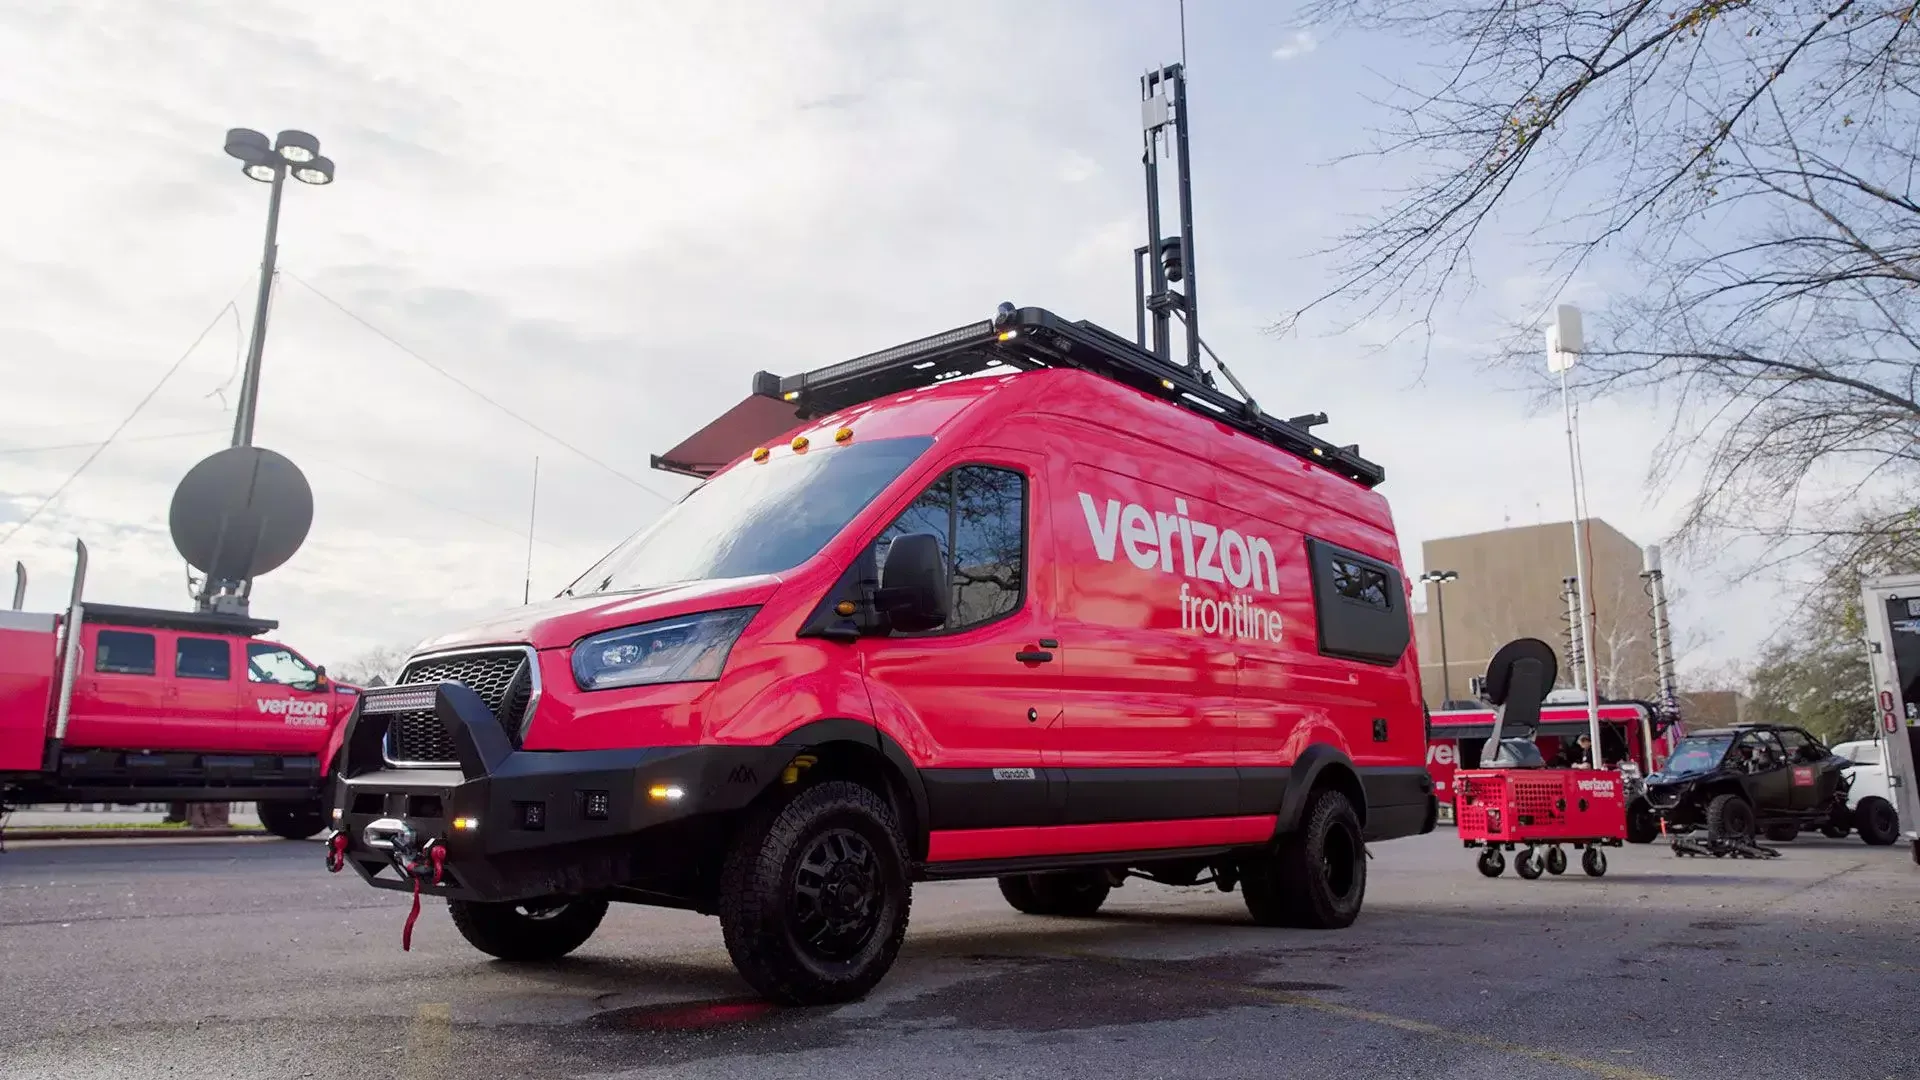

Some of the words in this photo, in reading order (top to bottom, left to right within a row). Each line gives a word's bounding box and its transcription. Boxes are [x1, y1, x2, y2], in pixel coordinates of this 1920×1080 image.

[1078, 492, 1279, 595] verizon
[1179, 583, 1284, 643] frontline
[257, 697, 328, 716] verizon
[1577, 778, 1614, 791] verizon
